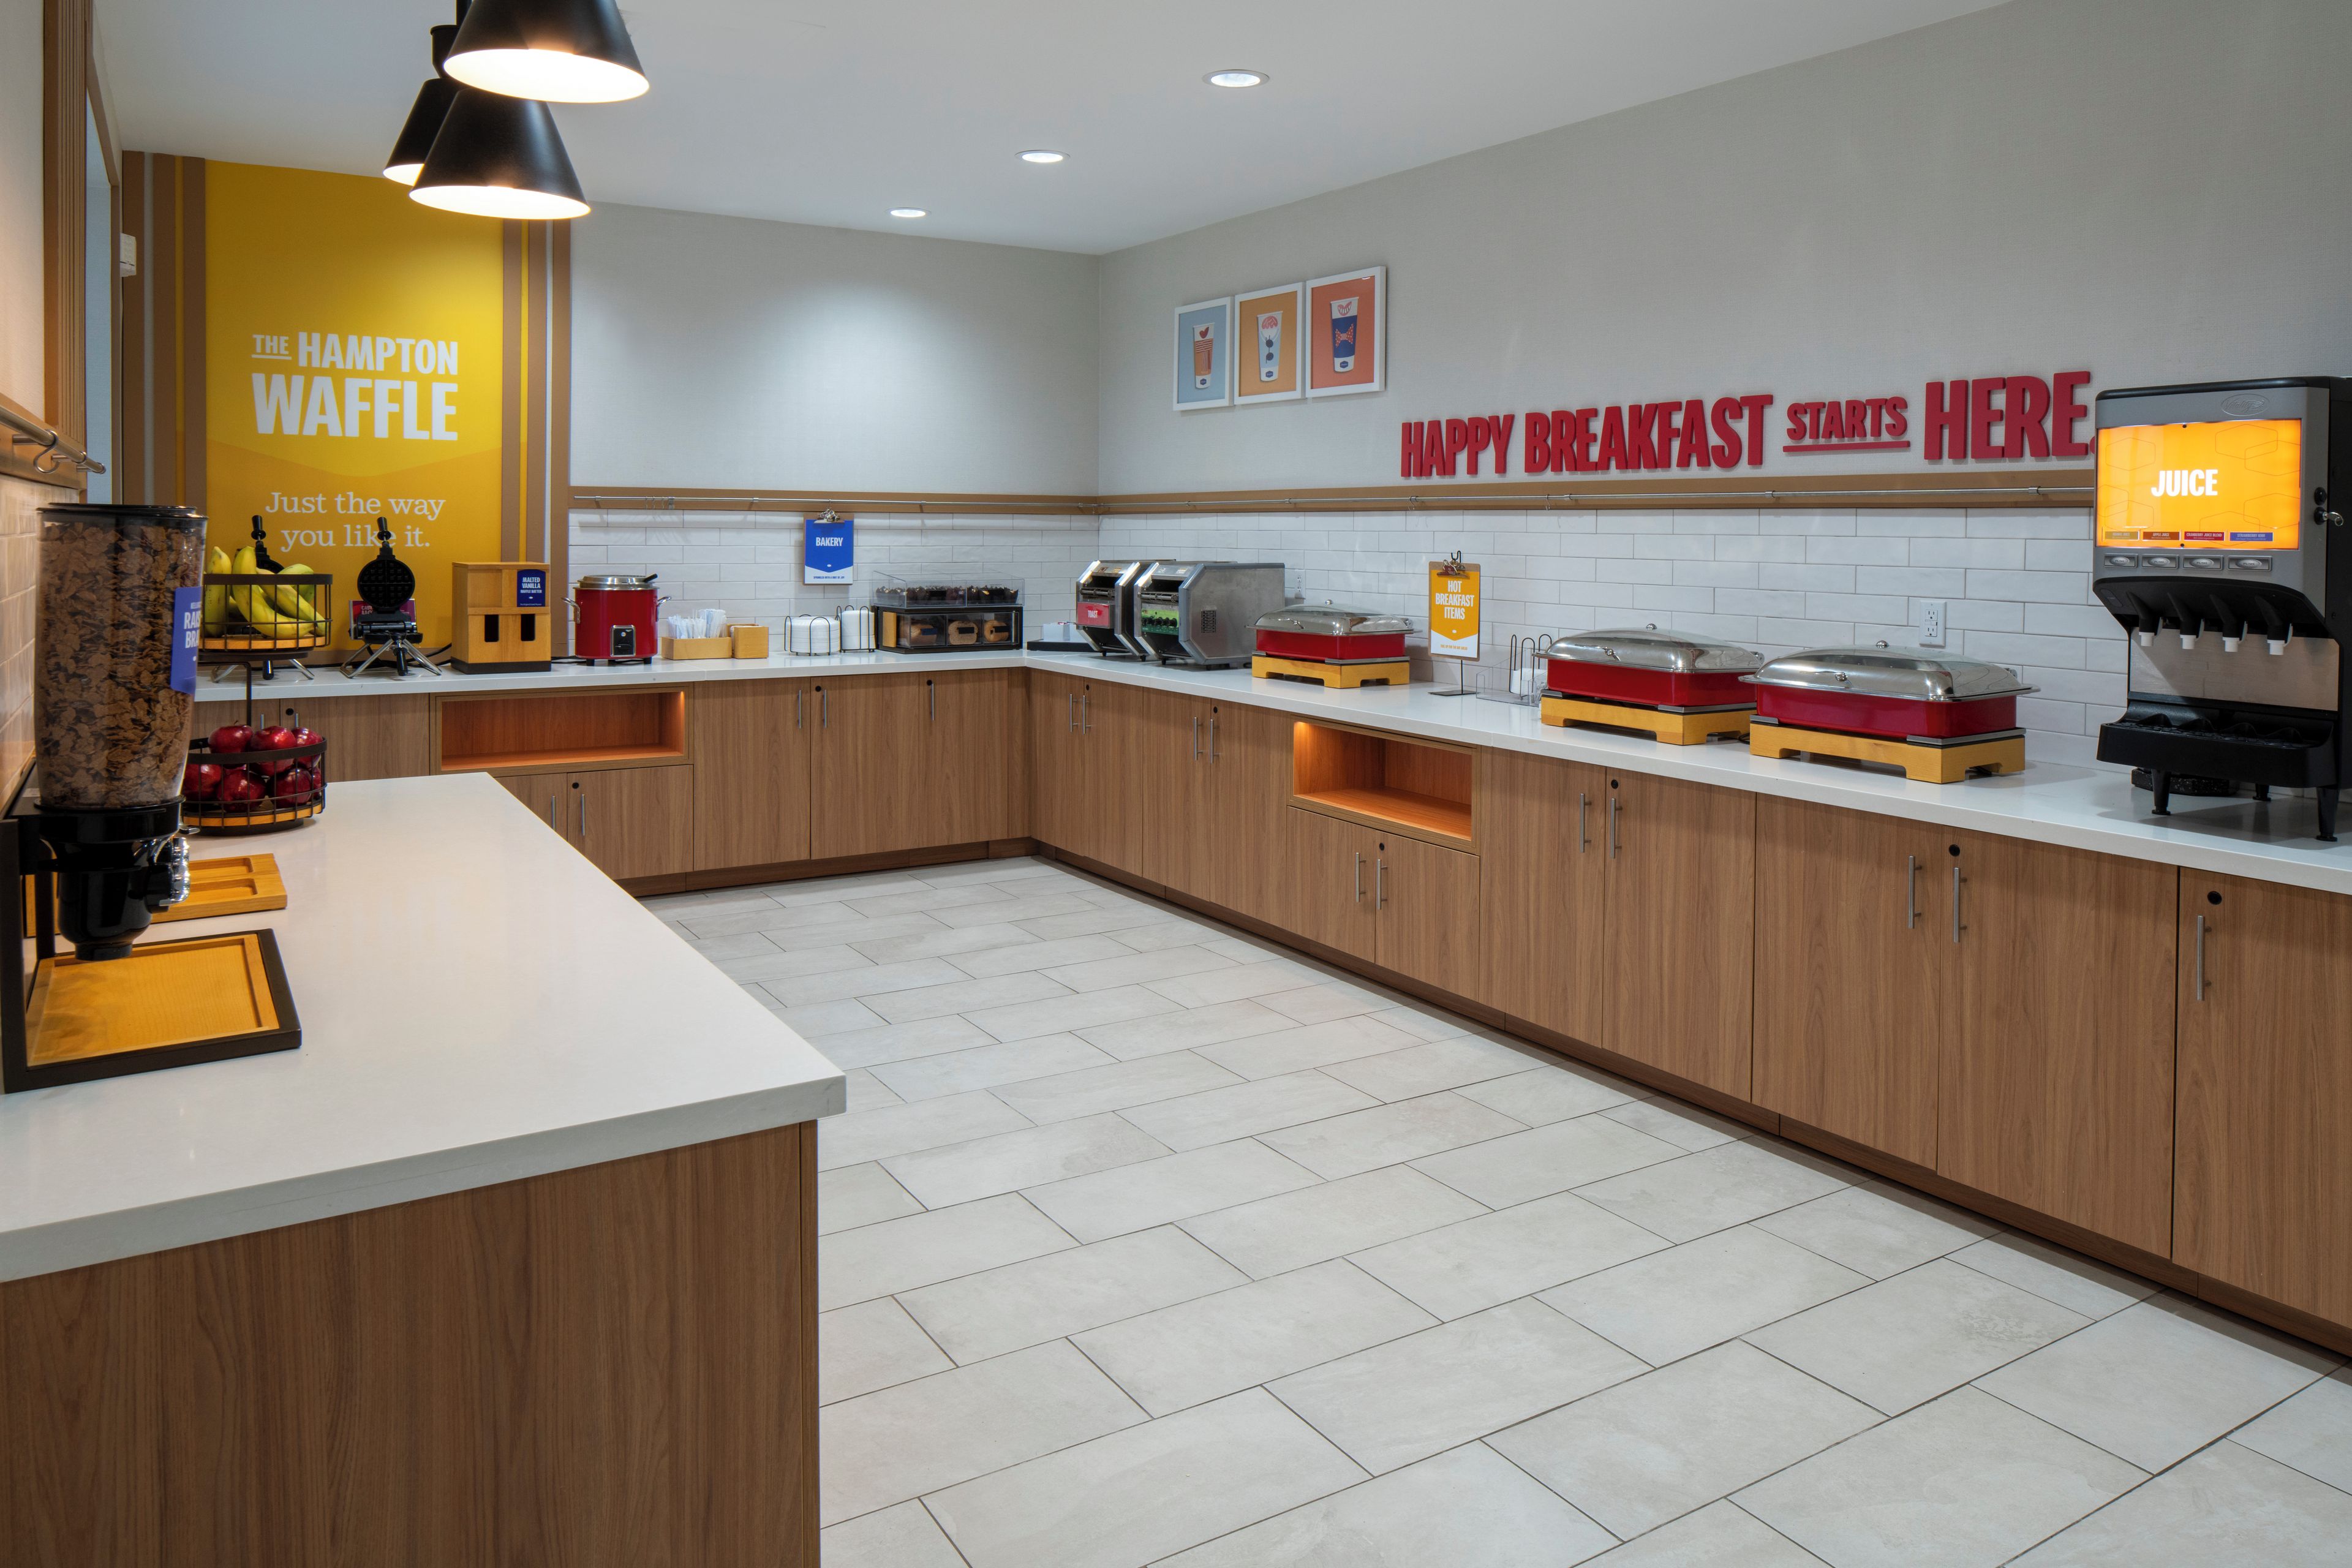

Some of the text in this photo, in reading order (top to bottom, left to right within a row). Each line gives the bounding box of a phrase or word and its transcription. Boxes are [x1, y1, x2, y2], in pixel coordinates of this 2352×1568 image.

[252, 331, 458, 374] THE HAMPTON
[251, 373, 458, 440] WAFFLE
[1401, 414, 1515, 478] HAPPY
[1525, 394, 1774, 473] BREAKFAST
[1786, 396, 1908, 441] STARTS
[2150, 469, 2218, 497] JUICE
[265, 491, 446, 521] Just the way
[281, 528, 336, 552] you
[405, 525, 431, 547] it.
[816, 537, 843, 546] BAKERY
[1435, 593, 1475, 607] BREAKFAST
[1447, 581, 1462, 592] HOT
[1444, 606, 1465, 620] ITEMS
